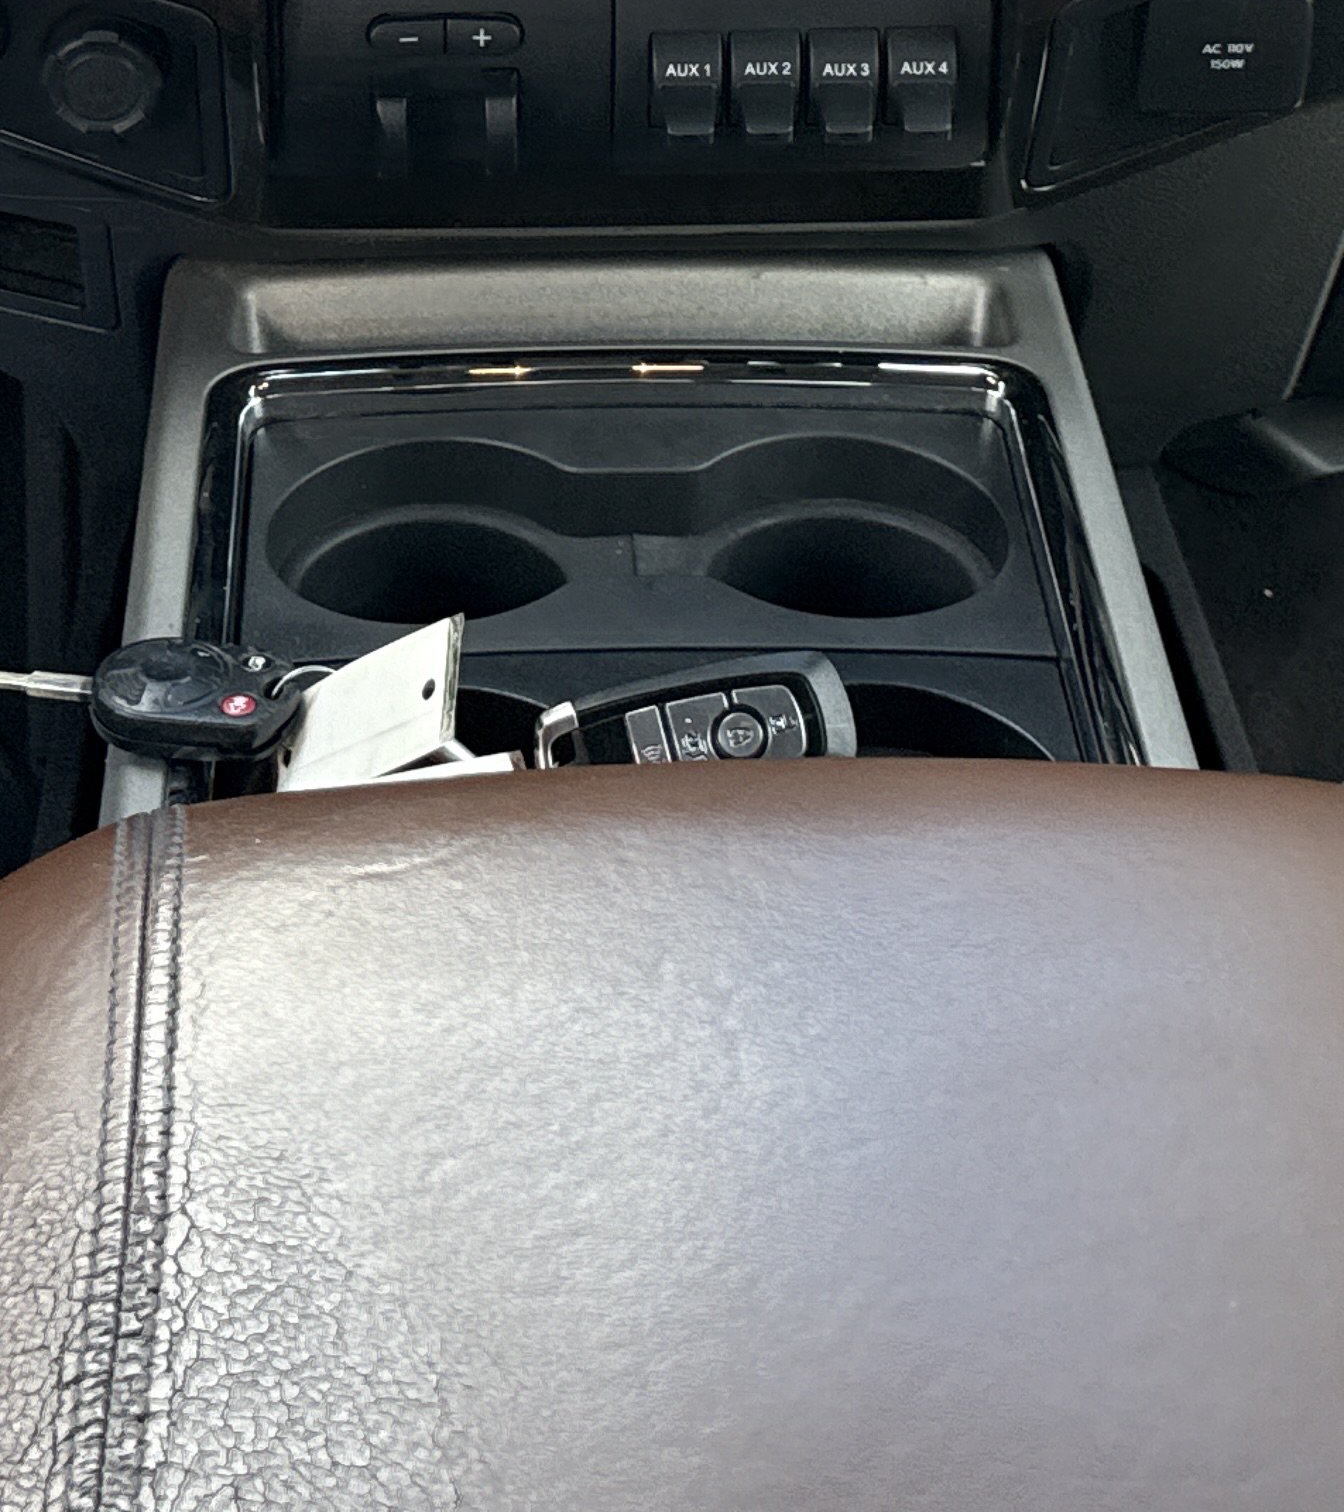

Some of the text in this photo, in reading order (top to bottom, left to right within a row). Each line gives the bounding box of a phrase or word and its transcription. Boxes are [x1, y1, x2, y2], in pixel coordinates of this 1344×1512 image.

[1201, 43, 1222, 54] AC
[665, 63, 711, 77] AUX 1
[744, 62, 792, 76] AUX 2
[822, 63, 870, 77] AUX 3
[900, 61, 949, 75] AUX 4
